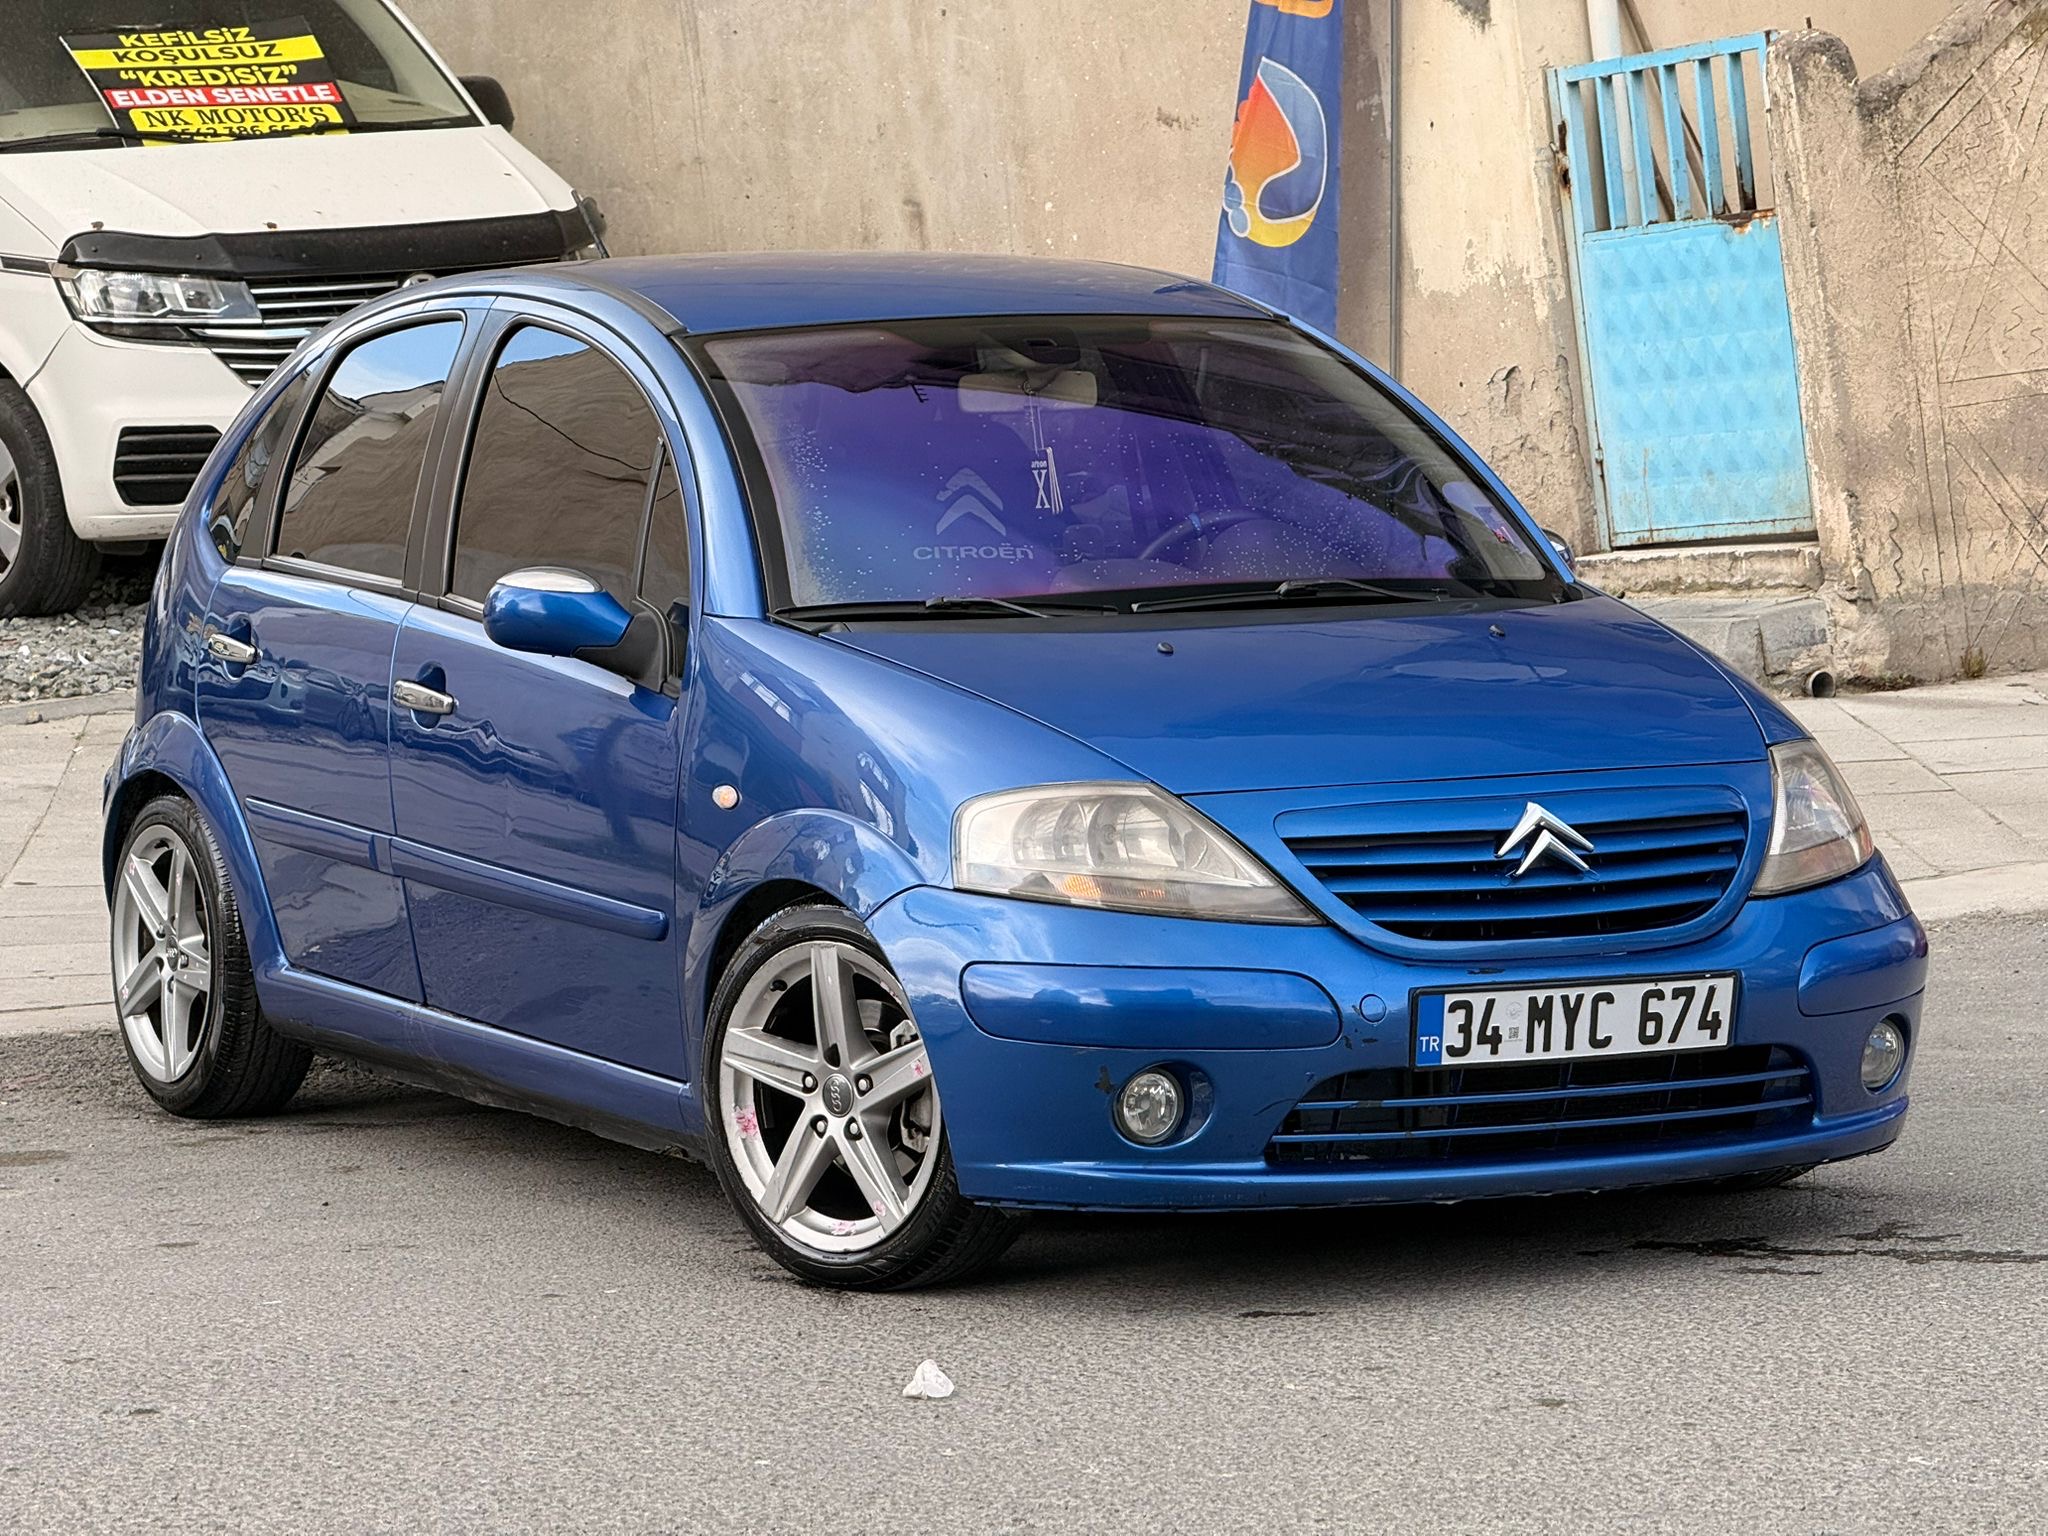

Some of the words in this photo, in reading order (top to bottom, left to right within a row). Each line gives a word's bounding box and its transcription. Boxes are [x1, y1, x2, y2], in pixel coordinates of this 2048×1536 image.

[112, 43, 282, 66] KOŞULSUZ
[111, 88, 209, 107] ELDEN
[211, 84, 336, 105] SENETLE
[141, 109, 191, 128] NK
[194, 106, 330, 126] MOTOR'S
[1031, 469, 1051, 509] X
[1445, 997, 1502, 1058] 34
[1525, 992, 1615, 1054] MYC
[1638, 984, 1723, 1046] 674
[1419, 1036, 1440, 1053] TR
